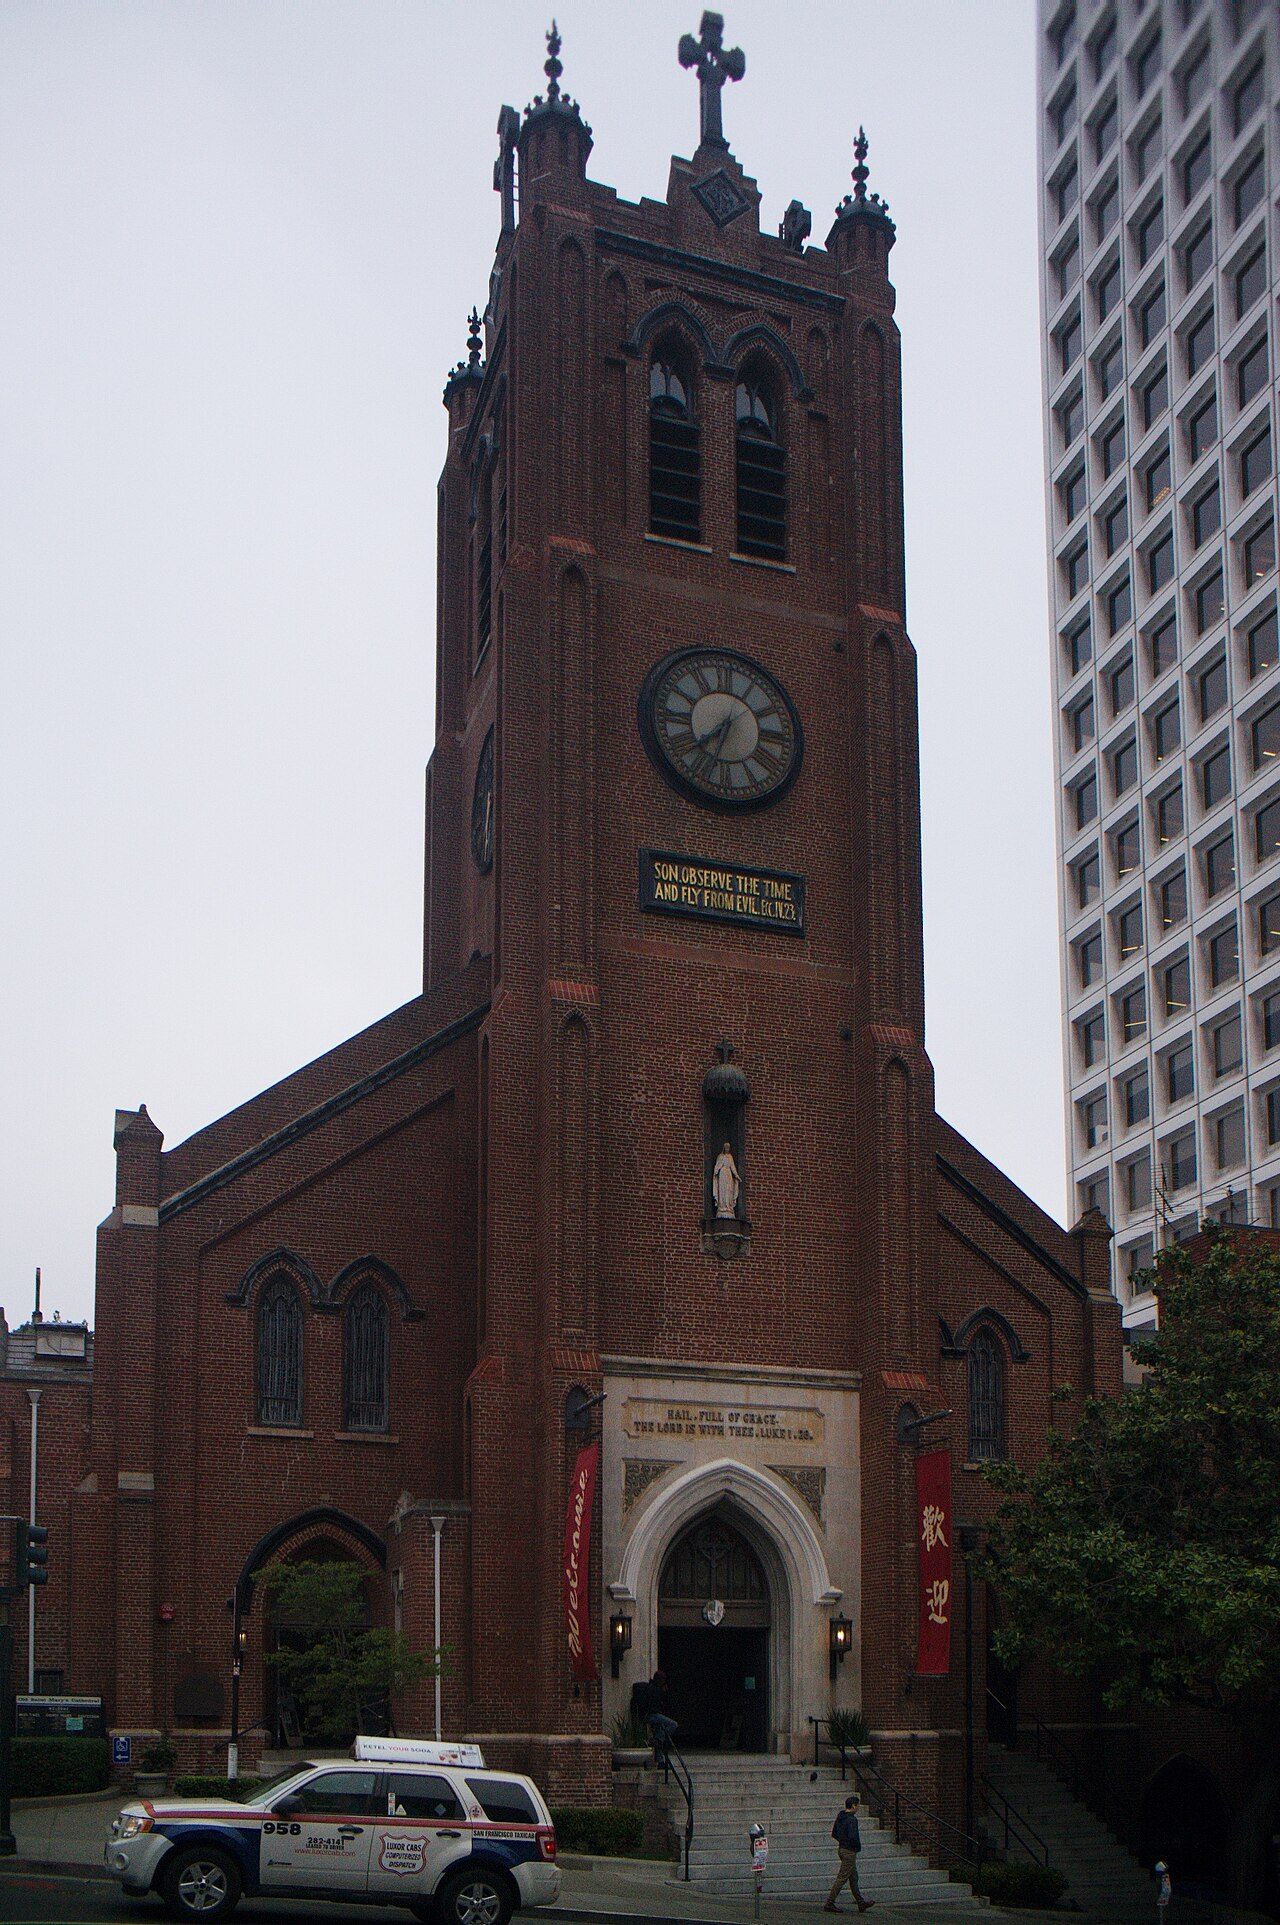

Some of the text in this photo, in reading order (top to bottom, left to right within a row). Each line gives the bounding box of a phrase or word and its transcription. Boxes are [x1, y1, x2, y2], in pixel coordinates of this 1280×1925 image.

[681, 866, 733, 891] OBSERVE
[736, 874, 760, 896] THE
[763, 880, 792, 901] TIME
[655, 882, 679, 902] AND
[681, 885, 702, 905] FLY
[704, 889, 734, 911] FROM
[699, 1411, 724, 1422] FULL
[728, 1412, 740, 1423] OF
[634, 1421, 654, 1432] THE
[657, 1422, 683, 1433] LORD
[685, 1424, 696, 1435] IS
[698, 1424, 724, 1436] WITH
[760, 1428, 786, 1439] LUKE
[263, 1822, 301, 1835] 958
[485, 1830, 513, 1838] FRANCISCO
[307, 1837, 344, 1846] 282-4141
[387, 1842, 422, 1852] LUXOR CABS
[385, 1851, 422, 1861] COMPUTERIZED
[388, 1861, 417, 1869] DISPATCH
